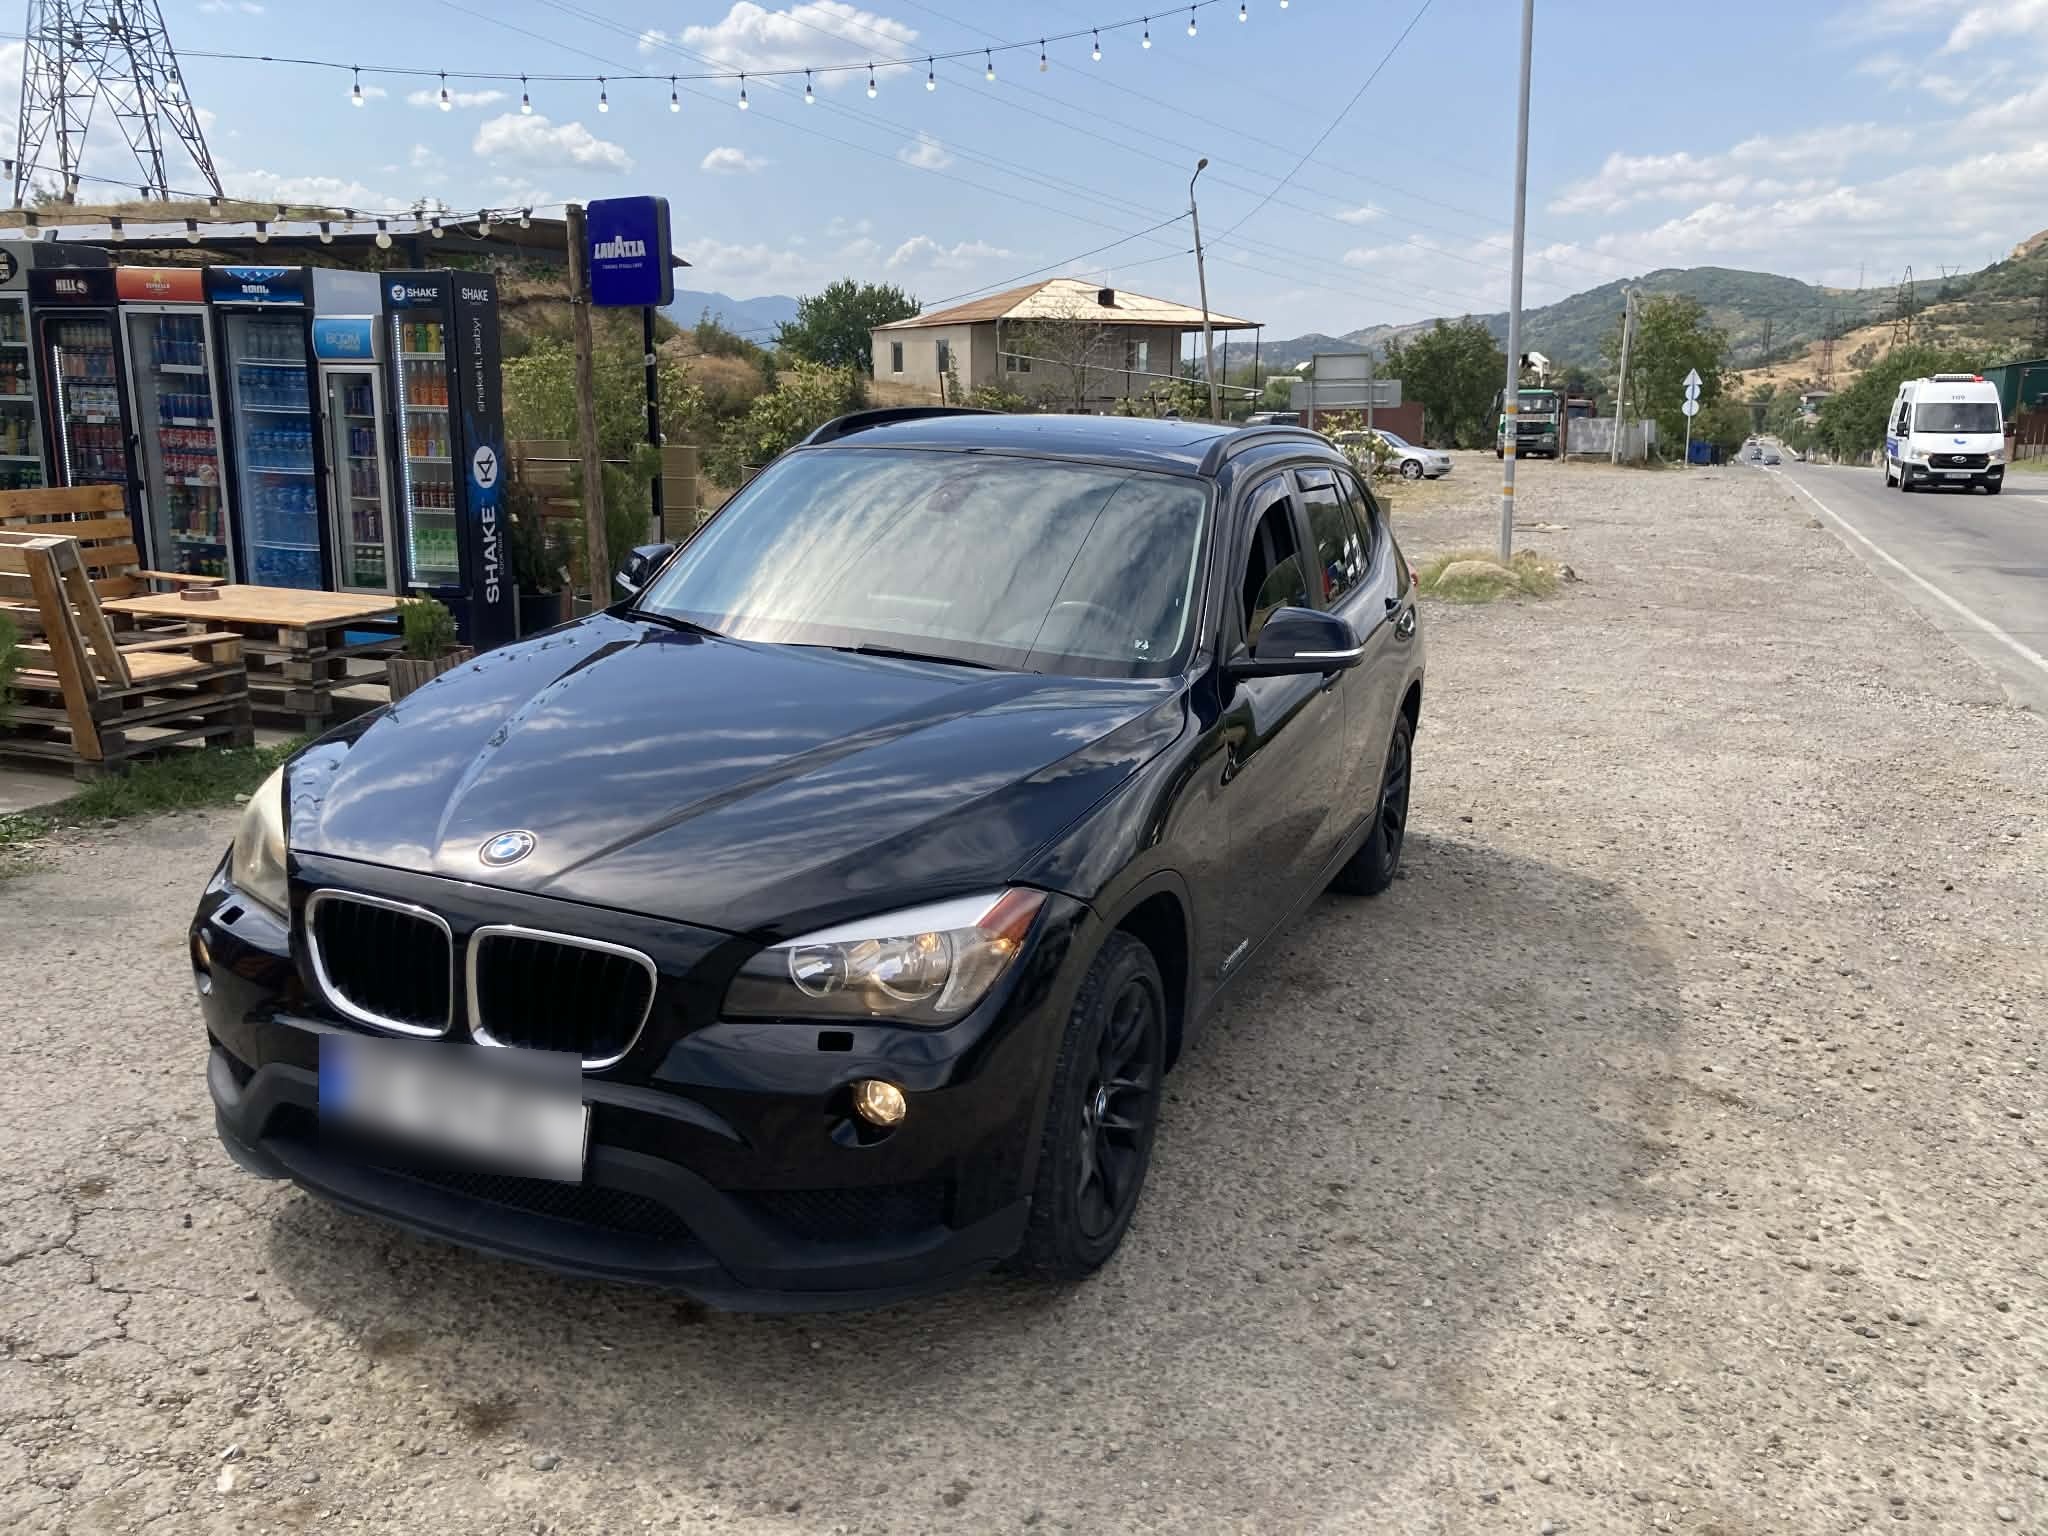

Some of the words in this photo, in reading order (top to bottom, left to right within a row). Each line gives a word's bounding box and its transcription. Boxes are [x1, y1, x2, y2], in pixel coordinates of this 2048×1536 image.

[594, 235, 646, 259] LAVAZZA
[55, 279, 77, 291] HELL
[406, 287, 438, 297] SHAKE
[461, 287, 489, 302] SHAKE
[481, 505, 500, 604] SHAKE
